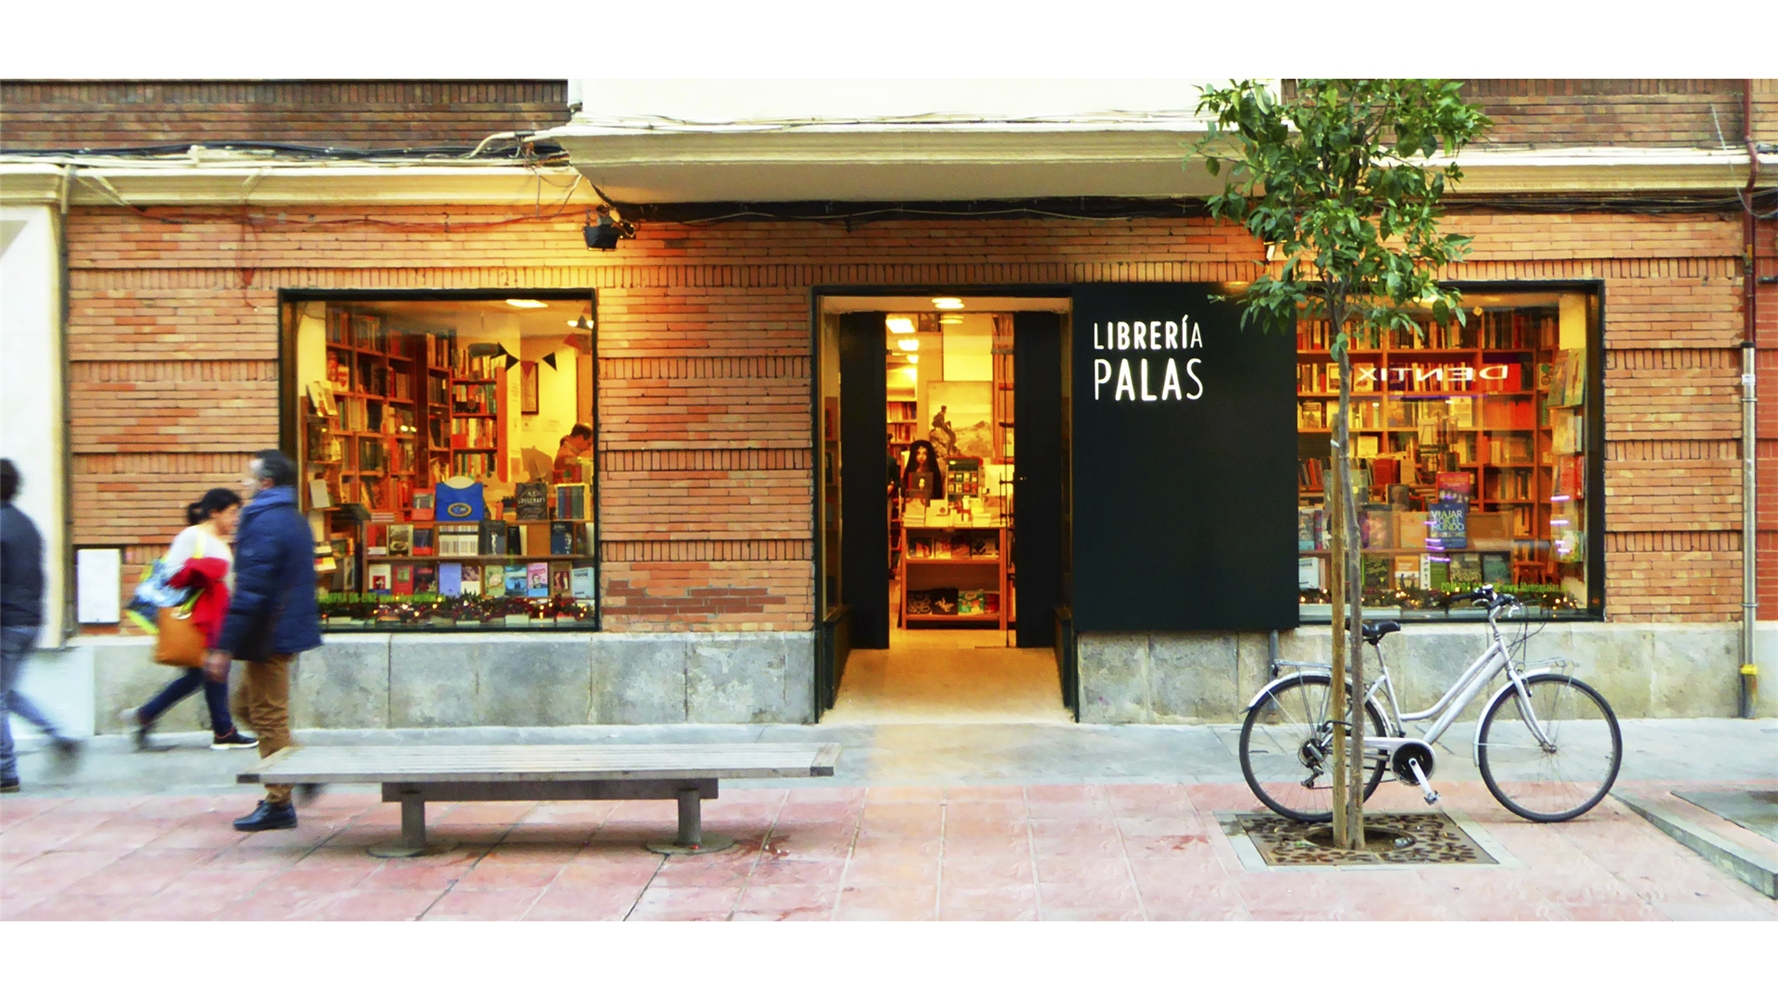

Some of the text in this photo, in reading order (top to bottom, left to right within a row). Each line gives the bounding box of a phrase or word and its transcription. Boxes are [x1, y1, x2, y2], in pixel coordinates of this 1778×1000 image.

[1093, 314, 1203, 350] LIBRERÍA
[1094, 358, 1204, 401] PALAS
[1430, 510, 1463, 519] VIAJAR
[1431, 522, 1465, 531] MUNDO
